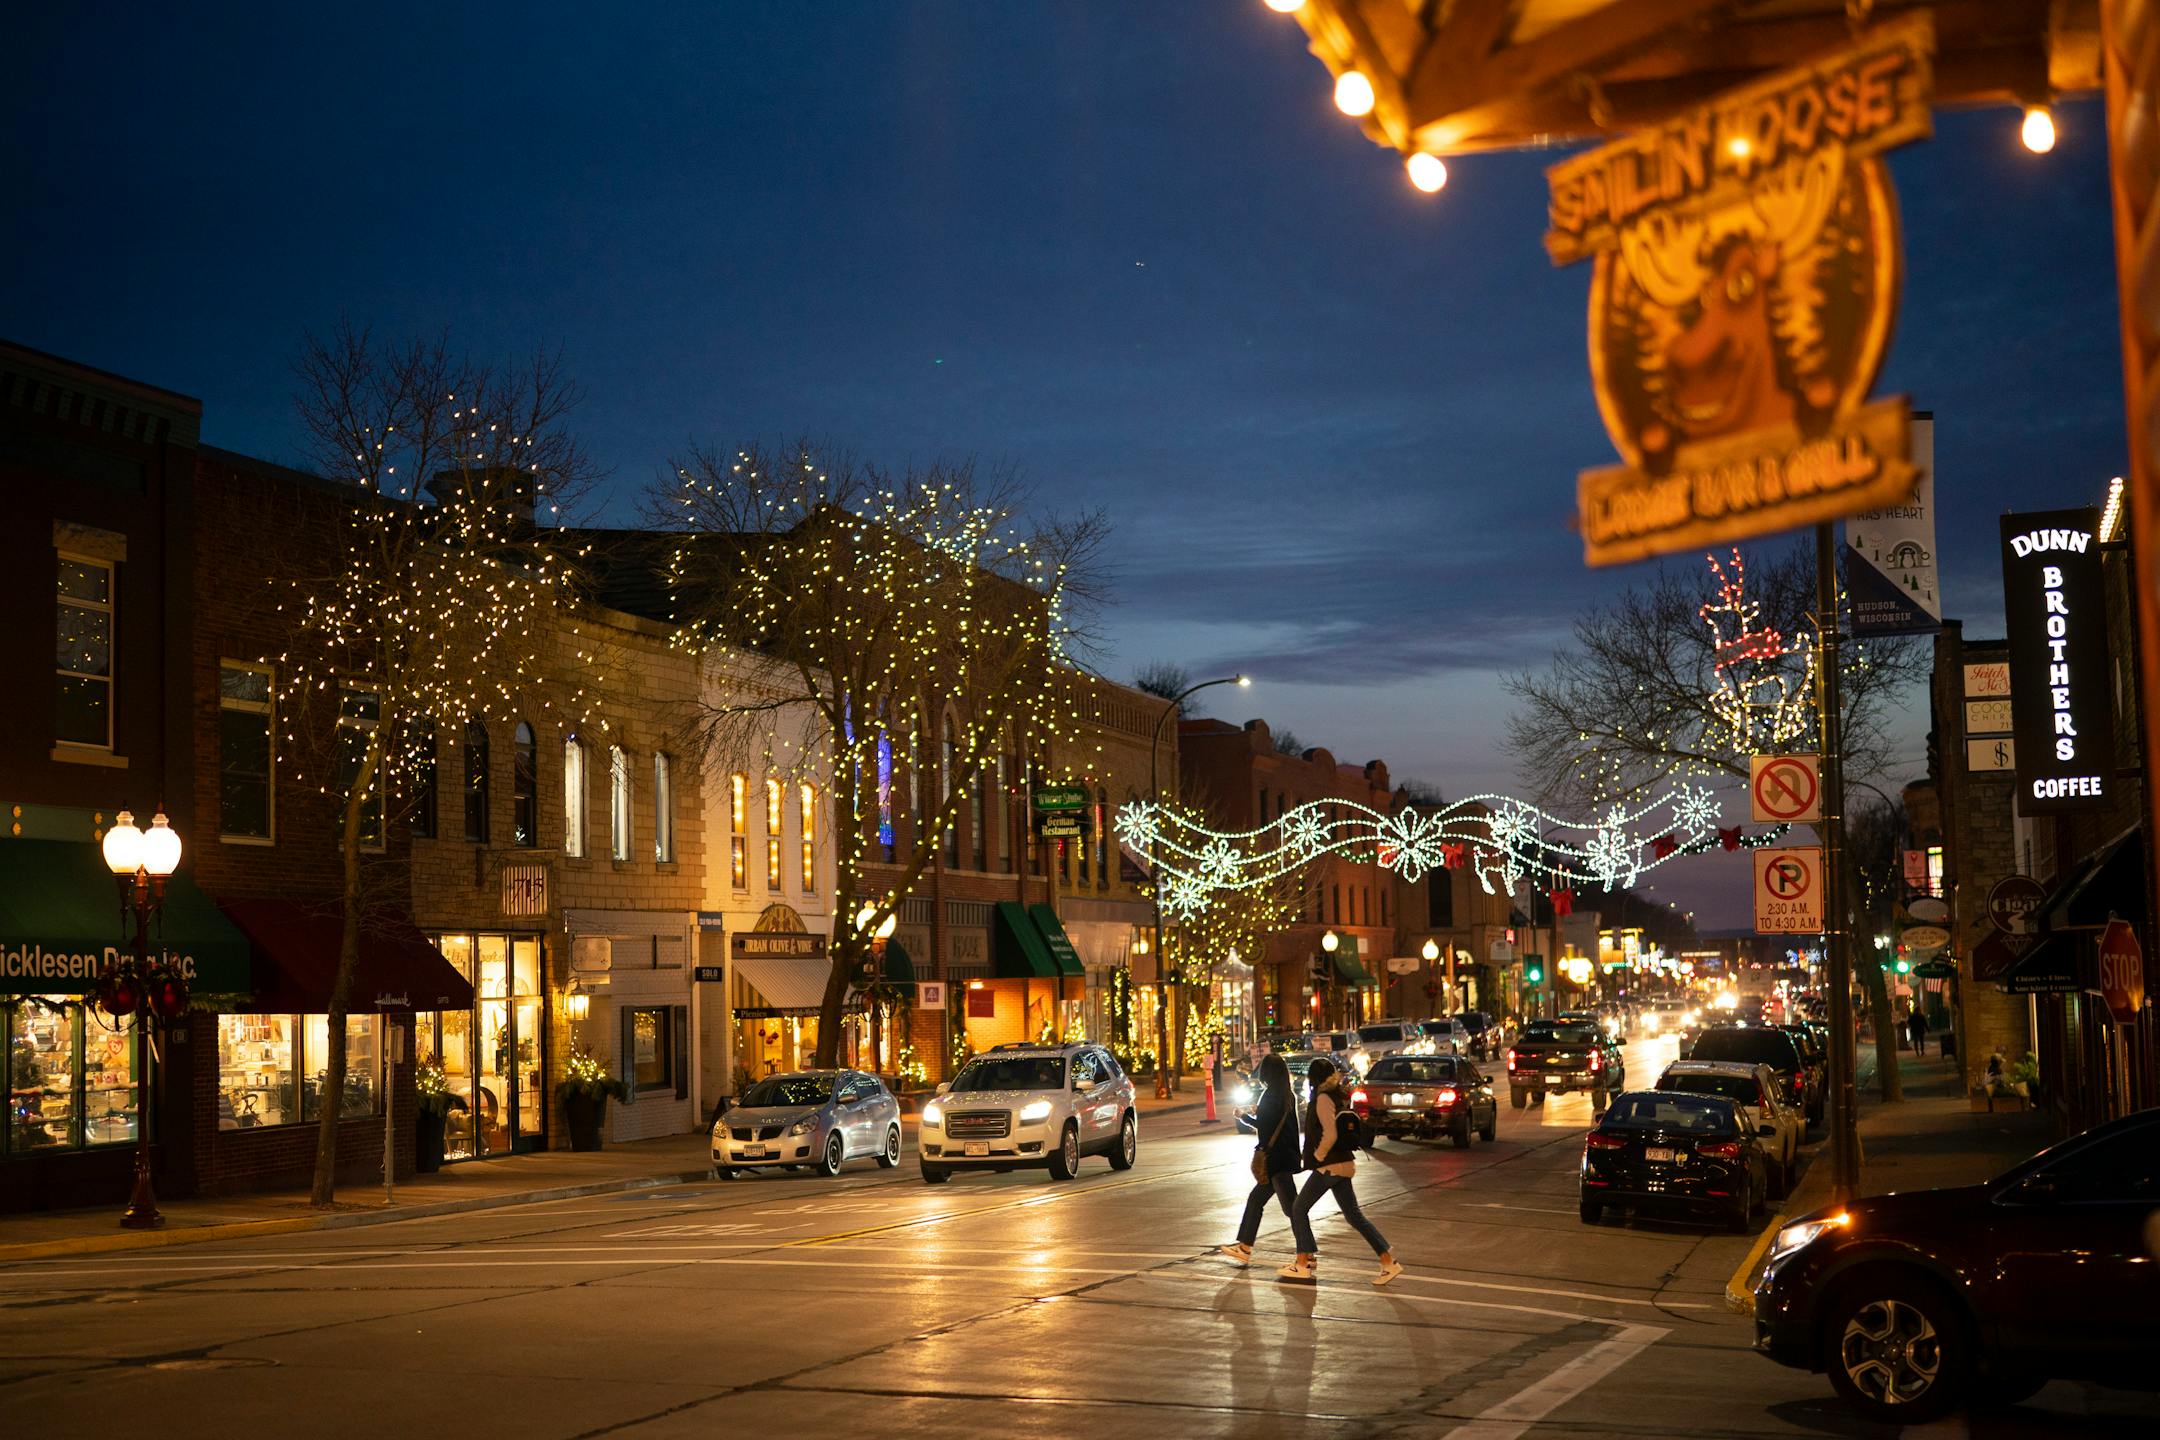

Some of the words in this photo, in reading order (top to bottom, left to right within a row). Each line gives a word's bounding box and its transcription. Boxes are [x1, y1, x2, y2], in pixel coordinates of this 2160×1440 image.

[1886, 507, 1925, 521] HEART
[2010, 528, 2092, 558] DUNN
[1857, 601, 1901, 612] HUDSON,
[1859, 612, 1912, 623] WISCONSIN
[2042, 566, 2077, 761] BROTHERS
[2032, 776, 2102, 799] COFFEE
[1046, 816, 1075, 826] German
[1041, 825, 1081, 836] Restaurant
[1767, 903, 1787, 915] 2:30
[1791, 903, 1810, 914] A.M.
[1759, 917, 1772, 929] TO
[1775, 917, 1796, 929] 4:30
[1799, 917, 1819, 929] A.M.
[744, 939, 768, 953] URBAN
[769, 939, 790, 953] OLIVE
[797, 939, 813, 953] VINE
[701, 969, 718, 978] SOLO
[2102, 952, 2140, 991] STOP
[374, 991, 411, 1012] Hallmark
